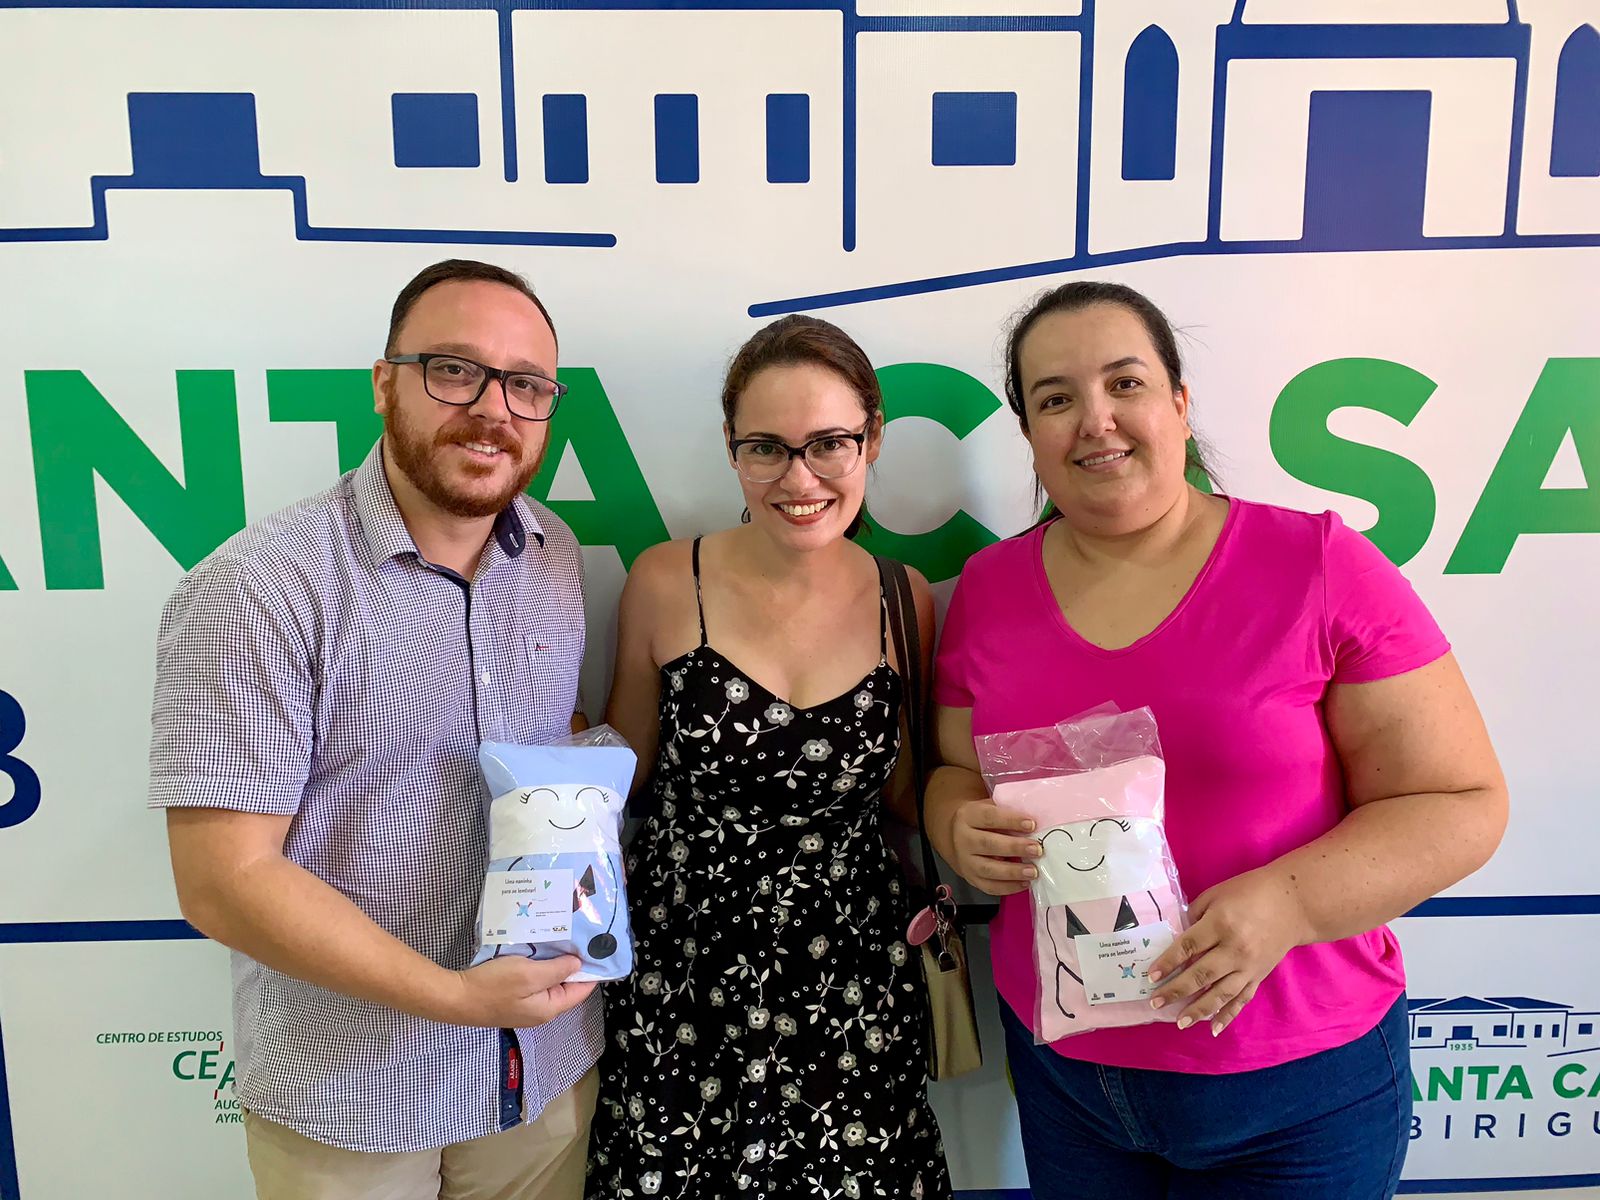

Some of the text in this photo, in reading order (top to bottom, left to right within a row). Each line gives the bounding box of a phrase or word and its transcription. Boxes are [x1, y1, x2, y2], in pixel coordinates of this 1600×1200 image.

[847, 357, 1600, 586] CSA
[96, 1031, 223, 1044] CENTRO DE ESTUDOS
[1450, 1043, 1473, 1051] 1935
[1411, 1063, 1600, 1102] NTA C
